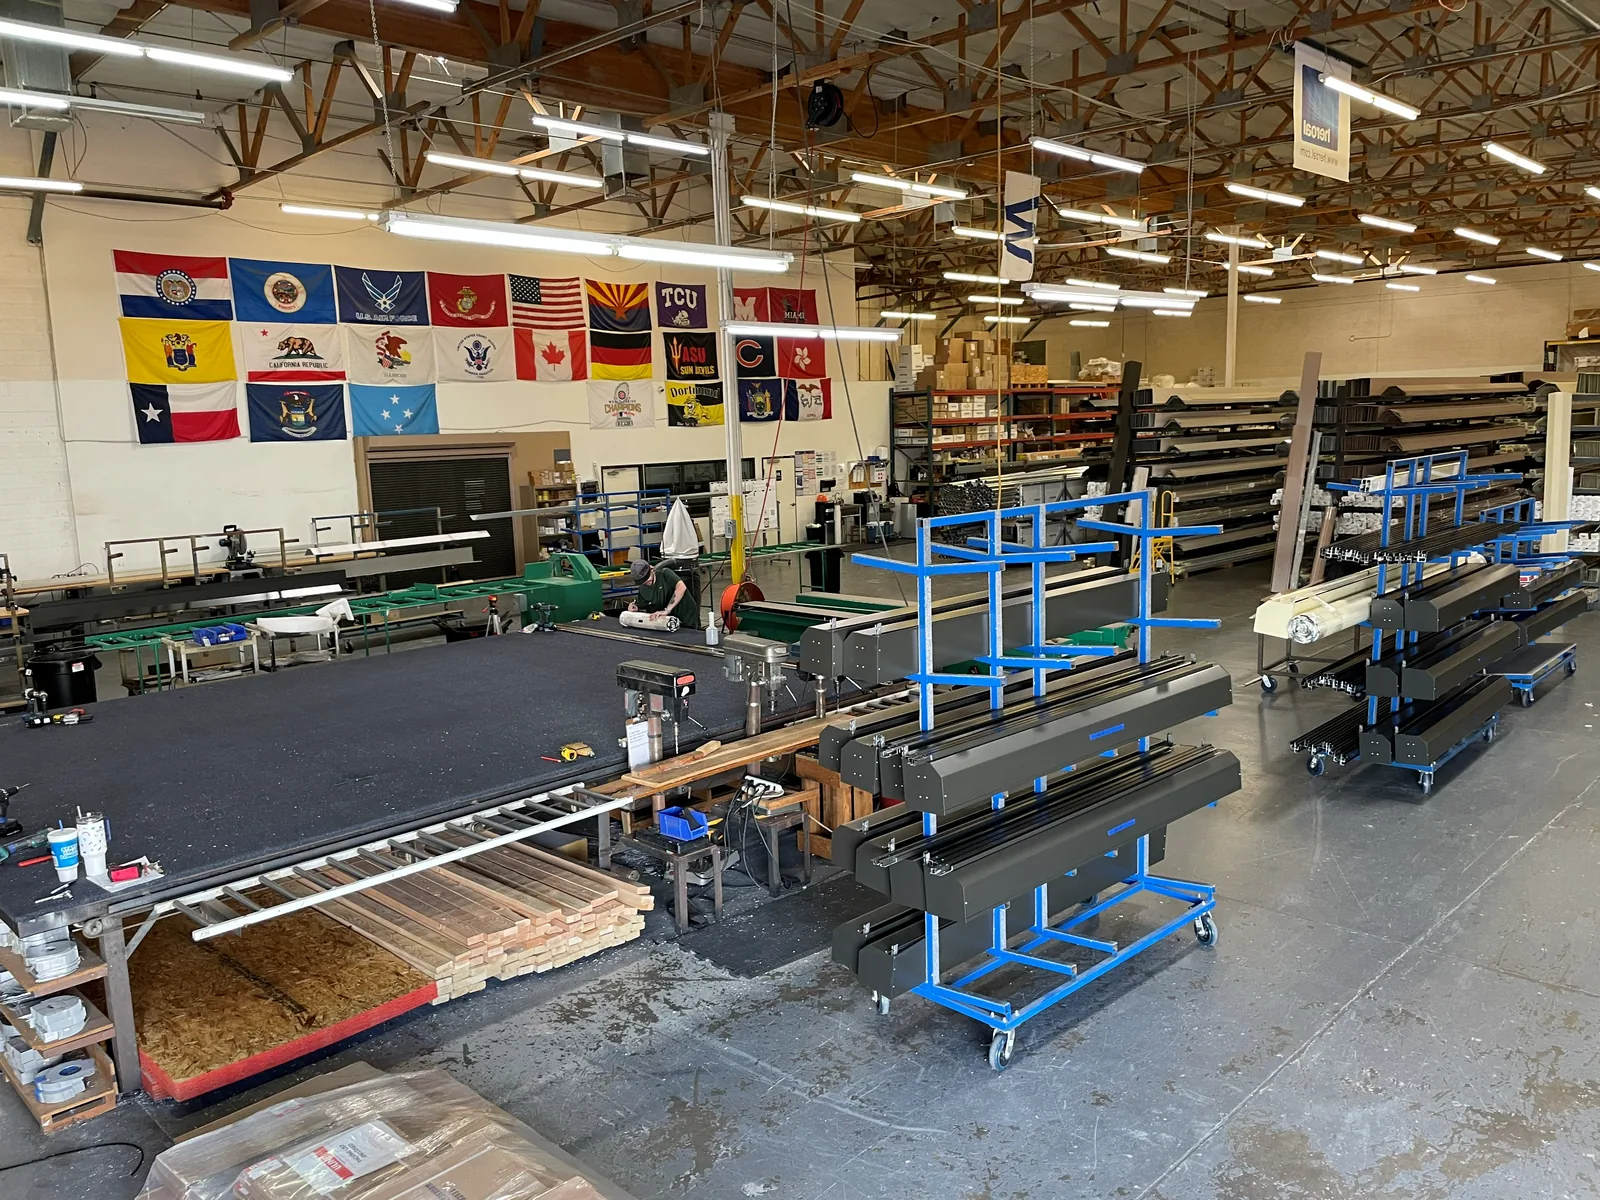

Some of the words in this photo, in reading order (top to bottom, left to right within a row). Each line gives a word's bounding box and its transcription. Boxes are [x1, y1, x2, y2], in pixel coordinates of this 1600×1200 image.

[662, 287, 698, 309] TCU
[734, 296, 758, 322] M
[356, 312, 372, 322] U.S.
[373, 313, 389, 322] AIR
[390, 314, 418, 322] FORCE
[682, 346, 706, 363] ASU
[736, 339, 764, 368] C
[268, 360, 300, 369] CALIFORNIA
[302, 360, 328, 369] REPUBLIC
[680, 366, 694, 374] SUN
[695, 366, 715, 374] DEVILS
[670, 386, 721, 399] Dortmund
[604, 403, 642, 414] CHAMPIONS
